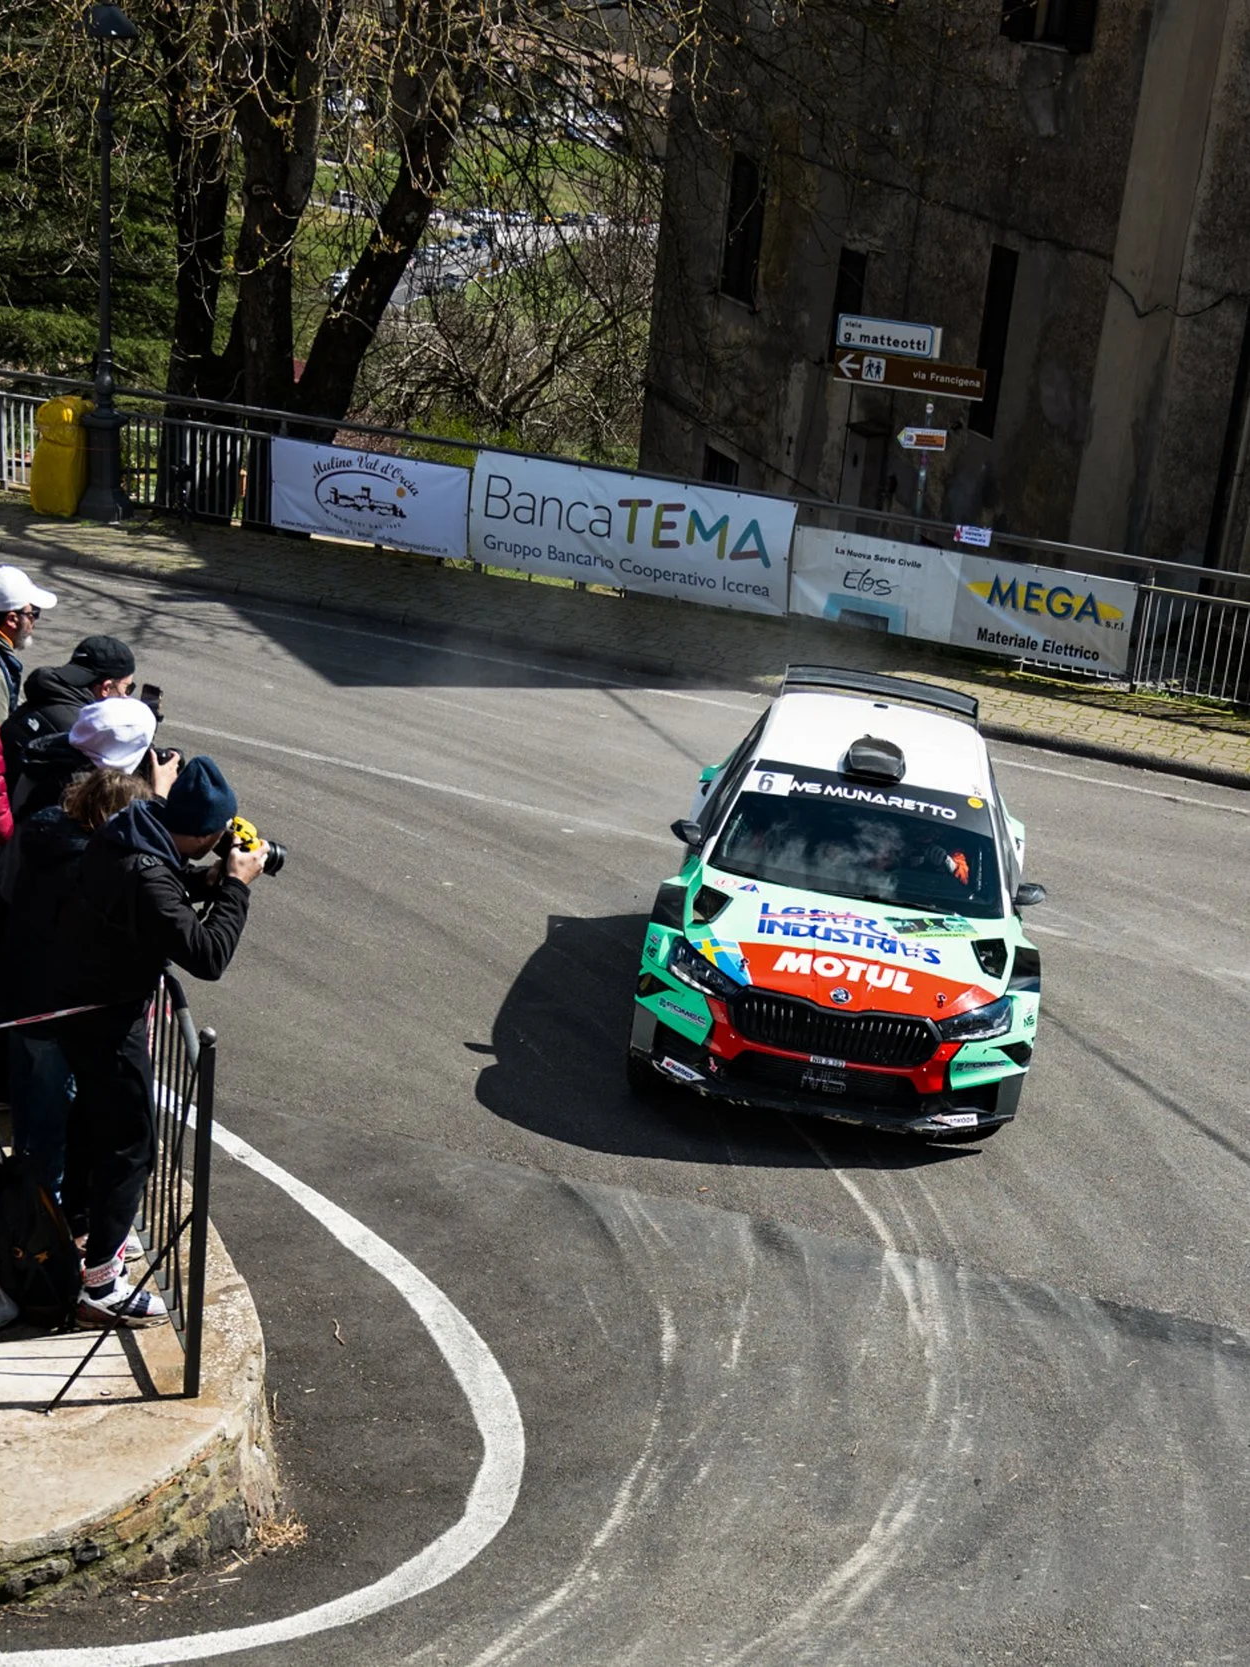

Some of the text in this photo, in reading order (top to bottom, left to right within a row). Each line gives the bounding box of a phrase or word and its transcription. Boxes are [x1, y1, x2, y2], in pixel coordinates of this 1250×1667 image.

[843, 331, 927, 352] g. matteotti
[912, 370, 981, 388] via Francigena
[312, 454, 419, 497] Mulino Val d'Orcia
[483, 474, 771, 569] BancaTEMA
[483, 534, 770, 598] Gruppo Bancario Cooperativo Iccrea
[835, 547, 922, 569] La Nuova Serie Civile
[986, 573, 1101, 626] MEGA
[976, 626, 1100, 662] Materiale Elettrico
[758, 774, 775, 792] 6
[823, 784, 957, 820] MUNARETTO
[757, 918, 942, 965] INDUSTRIES
[772, 951, 914, 995] MOTUL
